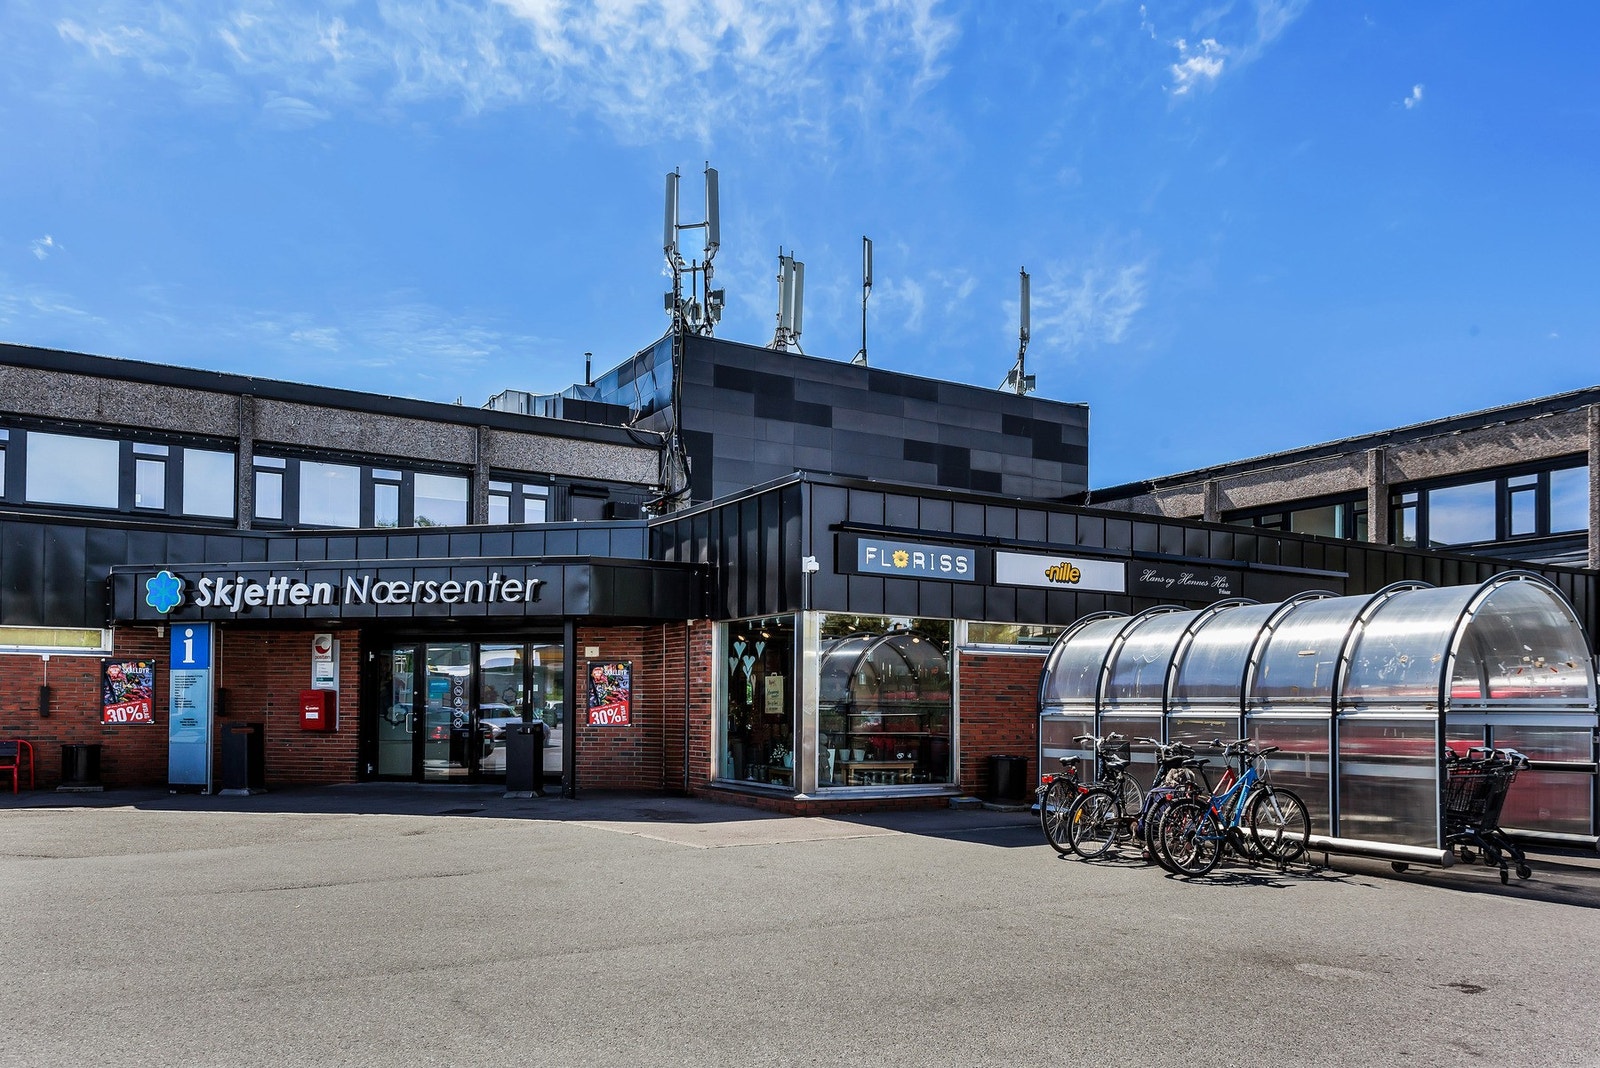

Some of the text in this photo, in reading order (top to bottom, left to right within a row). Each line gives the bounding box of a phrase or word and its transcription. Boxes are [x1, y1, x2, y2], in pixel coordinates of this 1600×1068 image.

[866, 547, 968, 574] FLORISS
[1048, 561, 1081, 584] nille
[1140, 569, 1164, 582] Hans
[1165, 577, 1175, 588] og
[1177, 572, 1209, 587] Hennes
[195, 572, 539, 613] Skjetten Nærsenter
[183, 628, 195, 664] i
[106, 704, 143, 722] 30%
[591, 707, 621, 725] 30%
